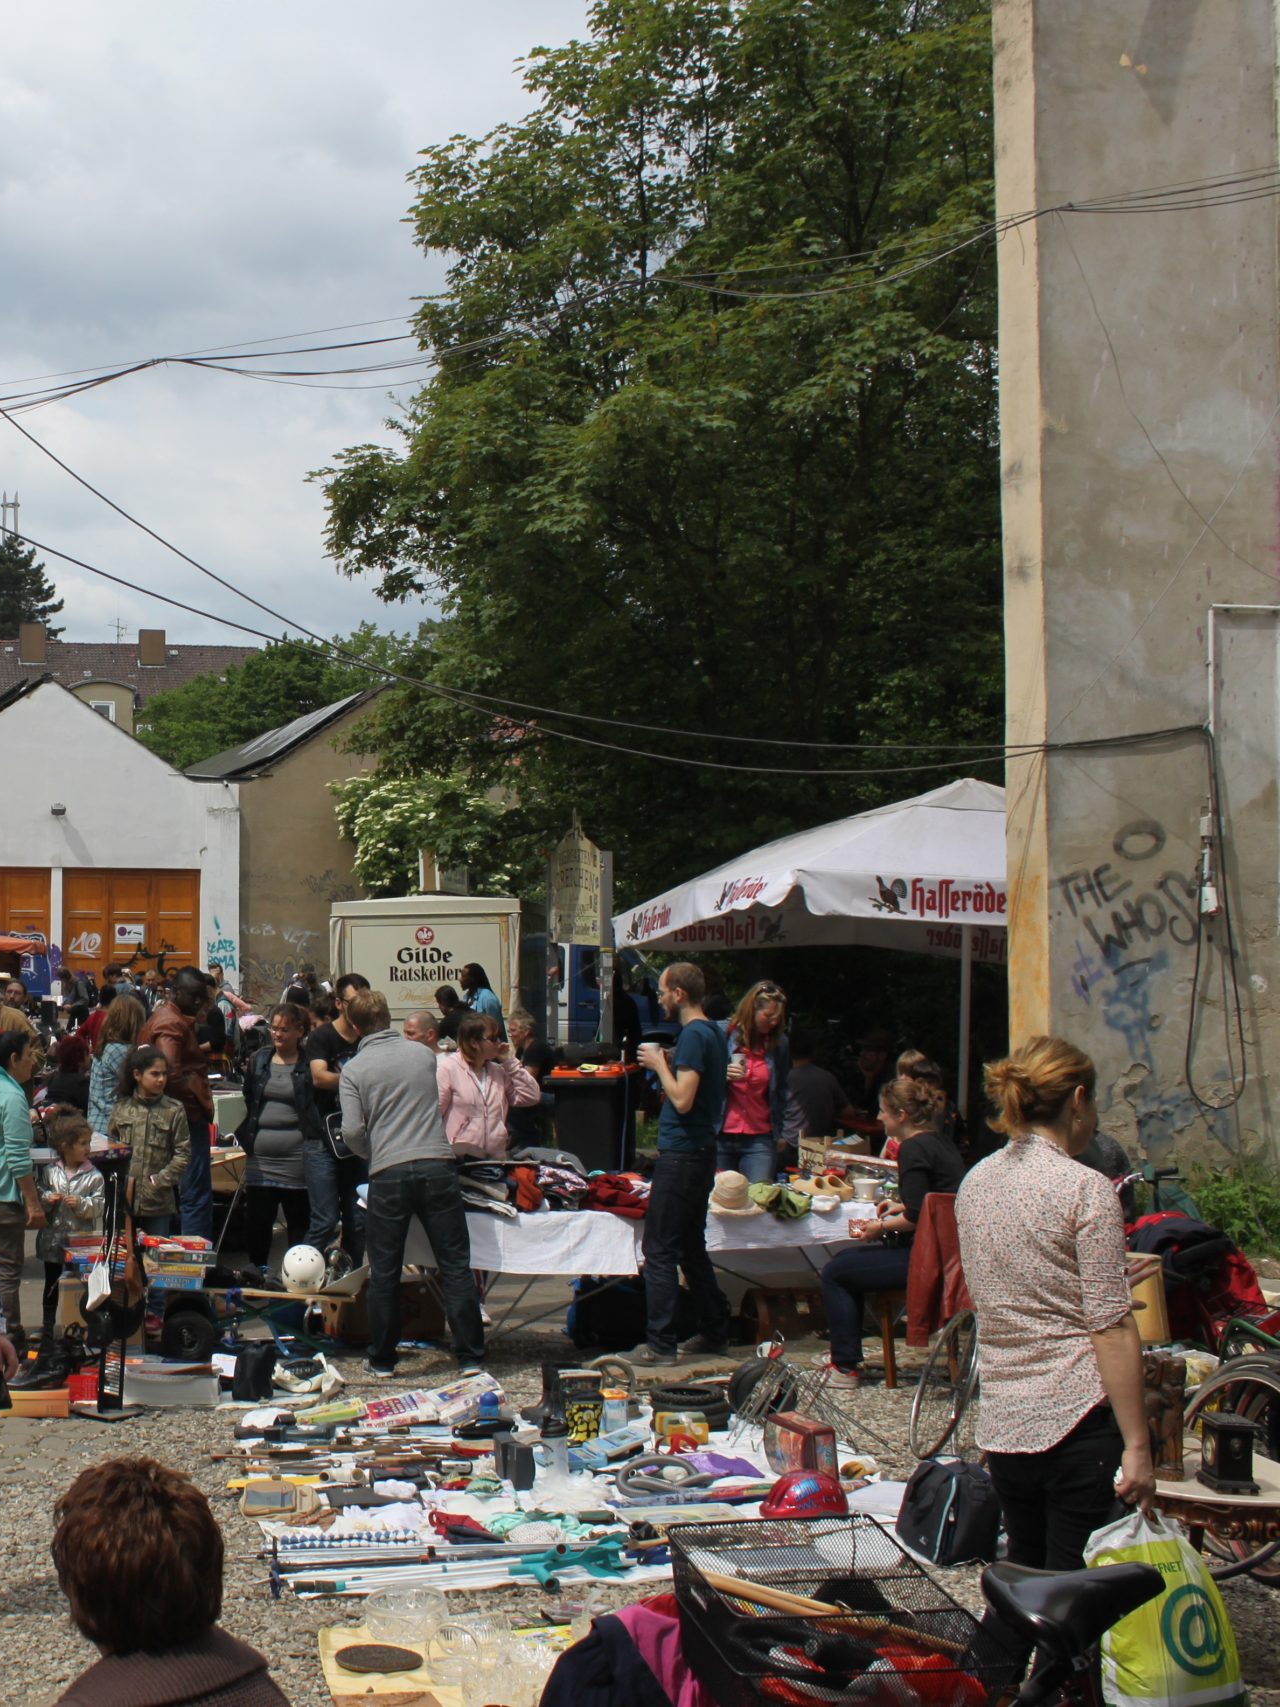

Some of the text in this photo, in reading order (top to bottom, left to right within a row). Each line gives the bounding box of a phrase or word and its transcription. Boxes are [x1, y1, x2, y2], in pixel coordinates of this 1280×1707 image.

[911, 877, 1007, 918] Hasseröde
[1057, 863, 1133, 918] THE
[397, 946, 453, 964] Gilde
[389, 965, 462, 982] Ratskeller
